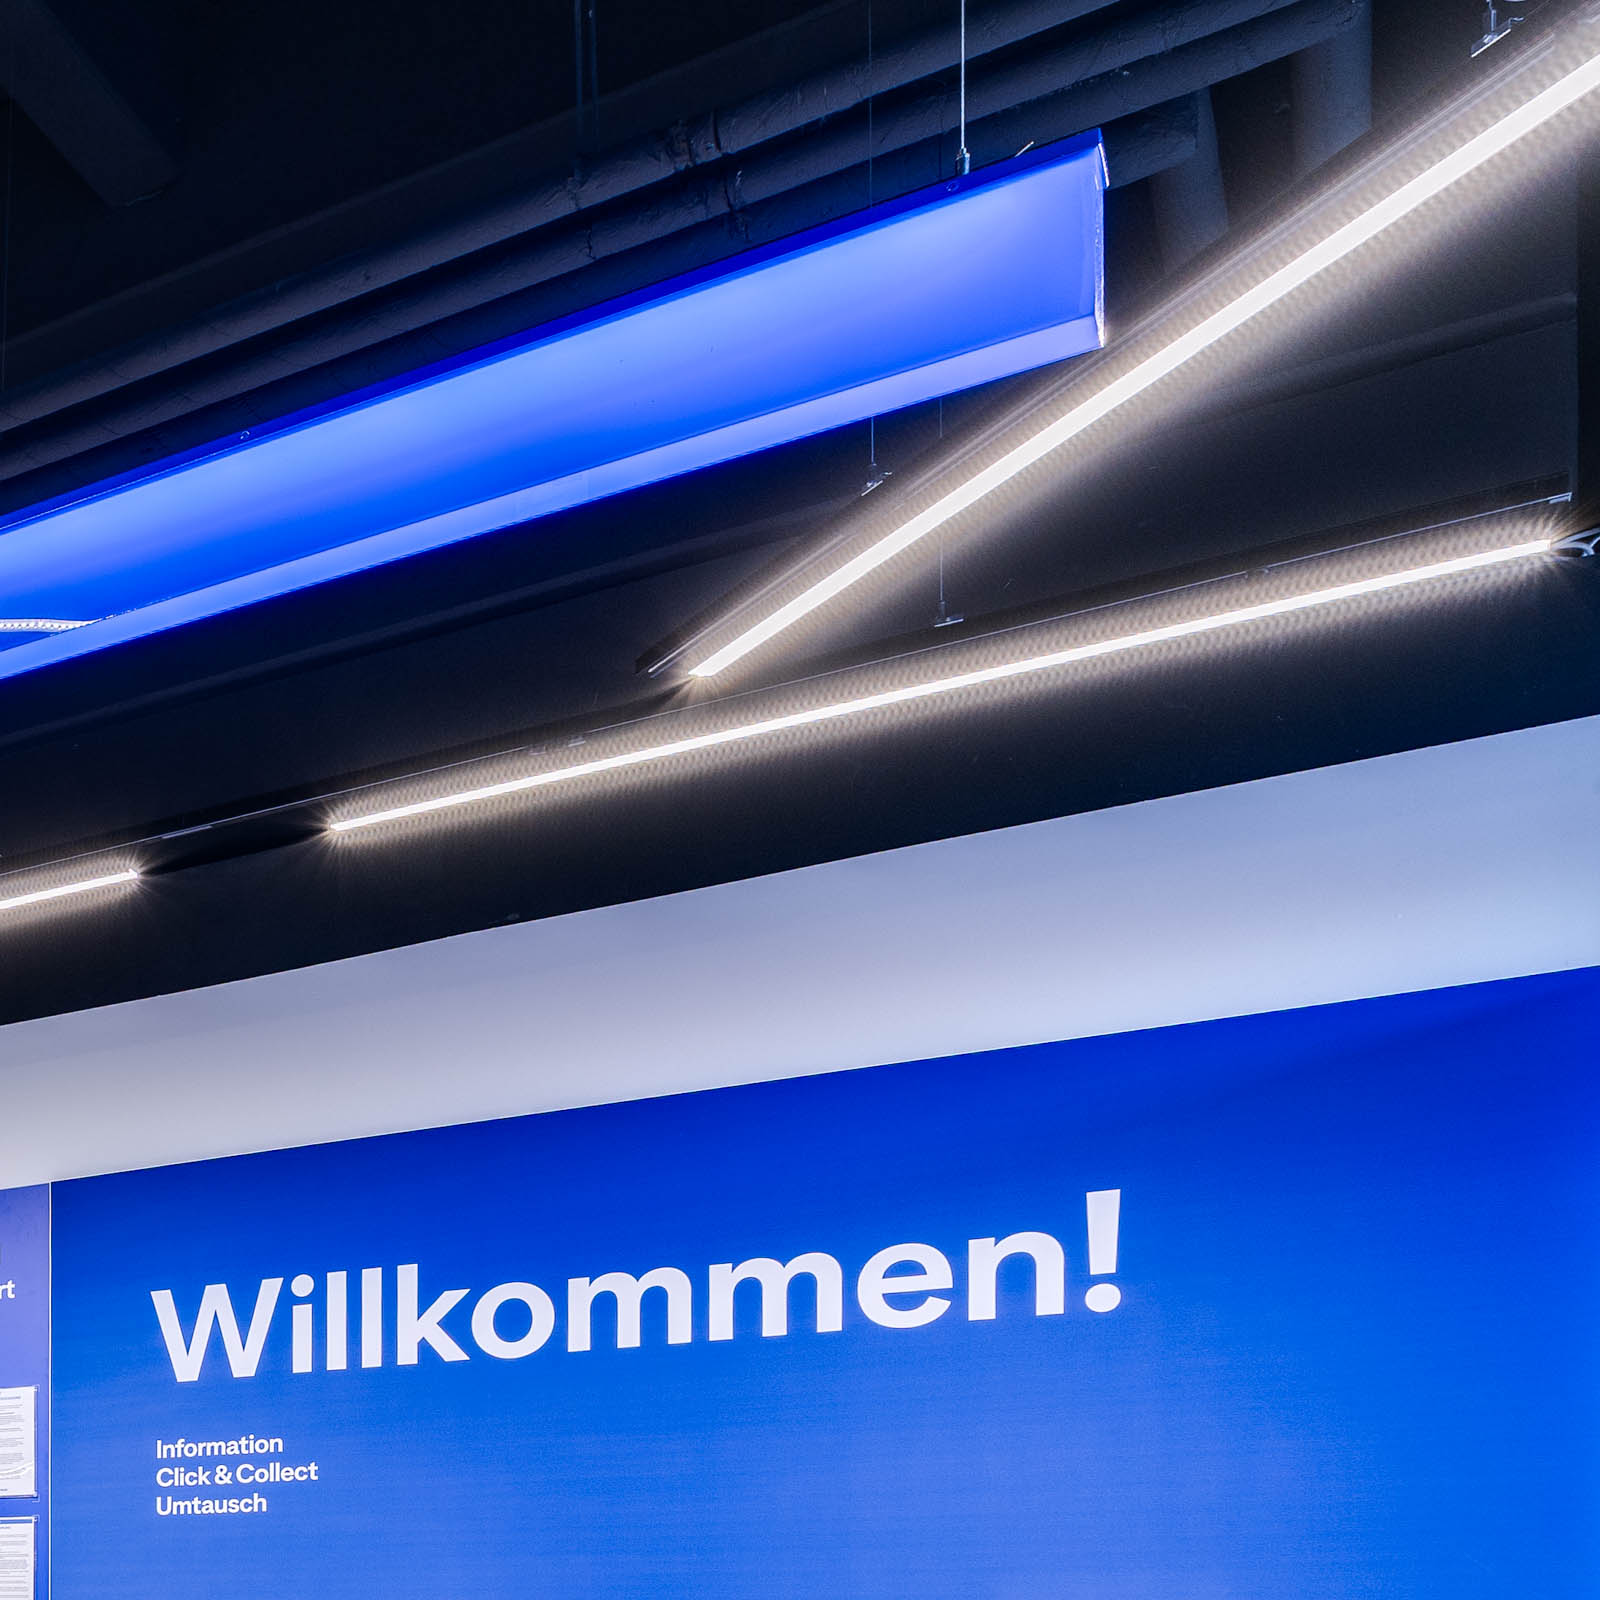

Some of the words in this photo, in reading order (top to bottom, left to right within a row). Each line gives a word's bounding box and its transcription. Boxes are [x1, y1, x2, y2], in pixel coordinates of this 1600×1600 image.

[150, 1188, 1122, 1383] Willkommen!
[156, 1434, 284, 1459] Information
[156, 1466, 212, 1487] Click
[214, 1465, 233, 1485] &
[235, 1461, 319, 1484] Collect
[156, 1492, 267, 1516] Umtausch
